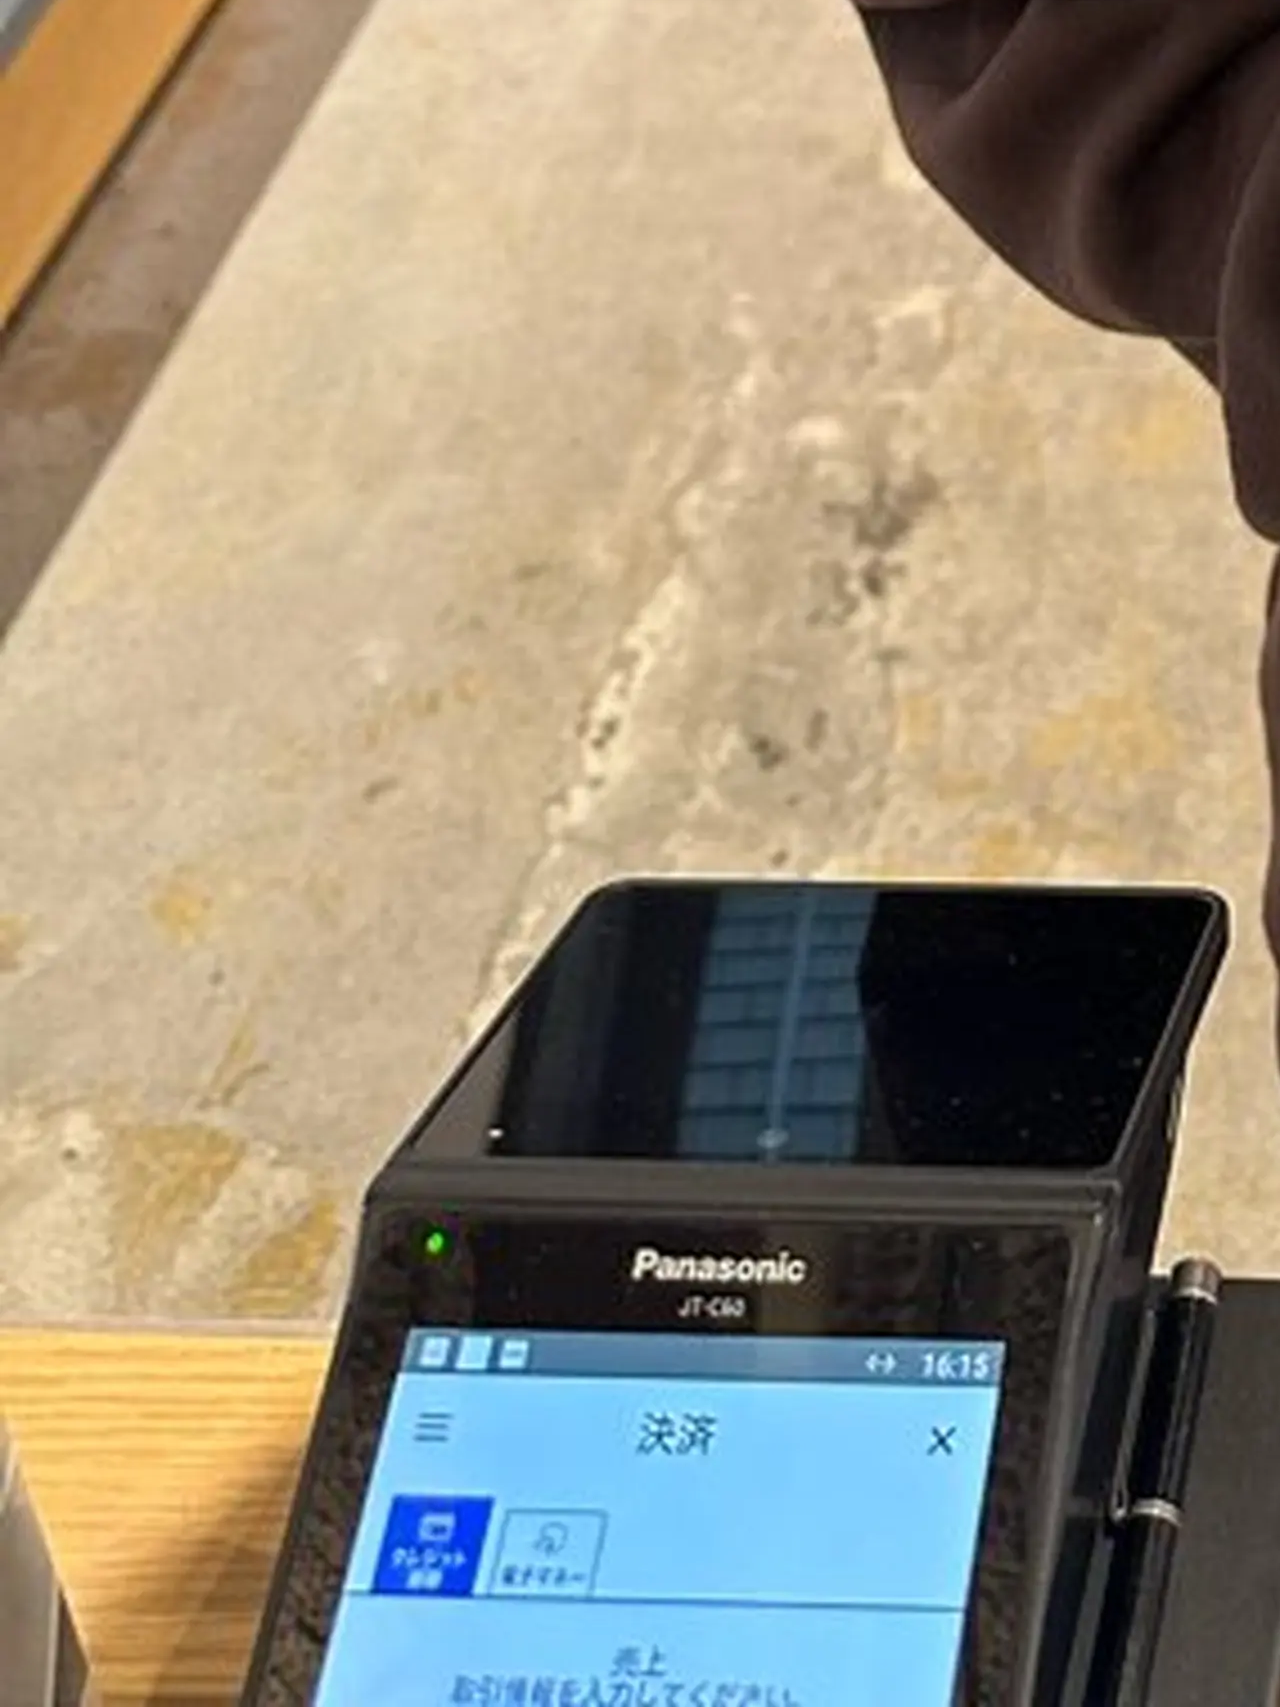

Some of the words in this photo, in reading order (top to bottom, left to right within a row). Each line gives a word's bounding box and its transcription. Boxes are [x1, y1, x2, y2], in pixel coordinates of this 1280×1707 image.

[631, 1248, 808, 1284] Panasonic
[922, 1351, 990, 1379] 16:15
[636, 1410, 718, 1455] 決済
[608, 1644, 668, 1678] 売上
